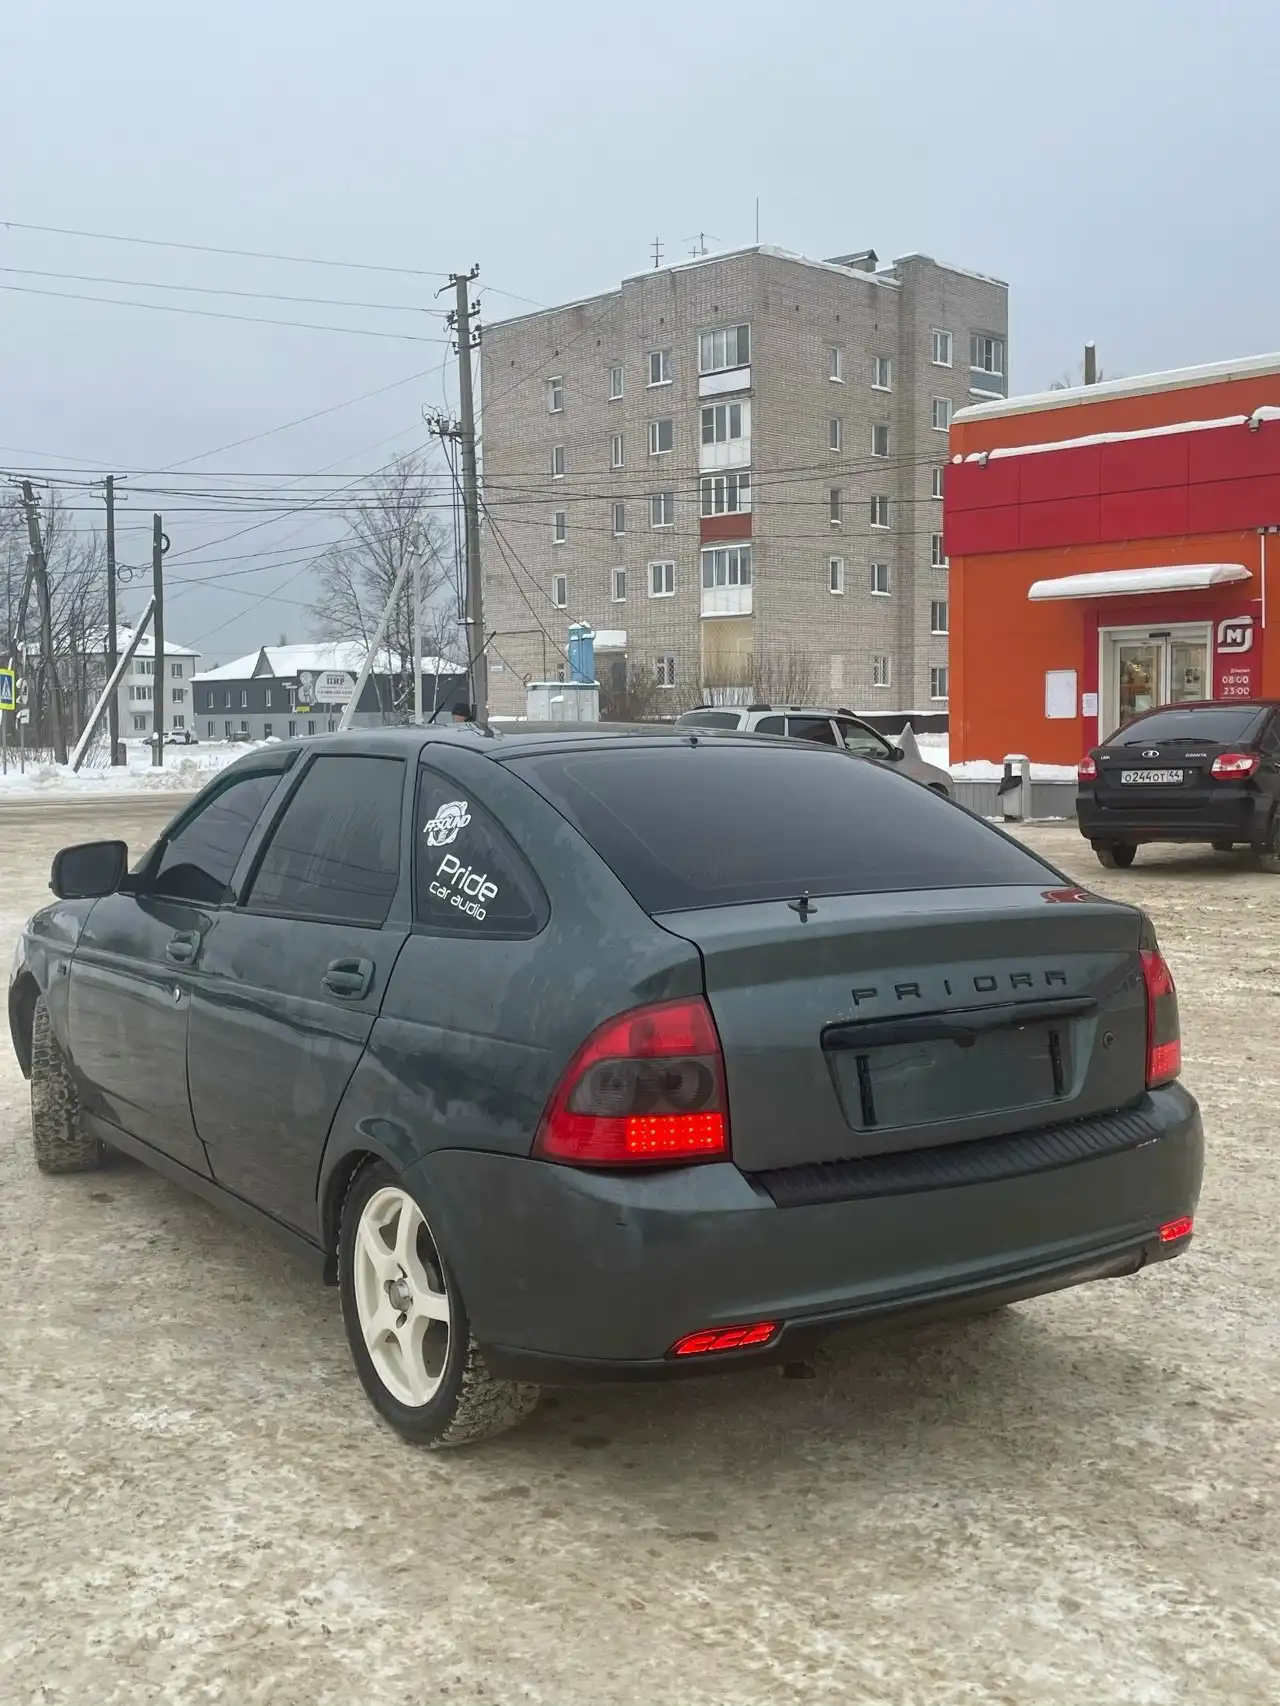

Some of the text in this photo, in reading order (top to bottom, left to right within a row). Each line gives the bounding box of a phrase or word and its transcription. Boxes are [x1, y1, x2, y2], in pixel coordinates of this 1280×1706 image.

[1168, 770, 1180, 779] 44
[436, 853, 499, 902] Pride
[429, 881, 487, 921] car audio
[851, 970, 1067, 1006] PRIORA
